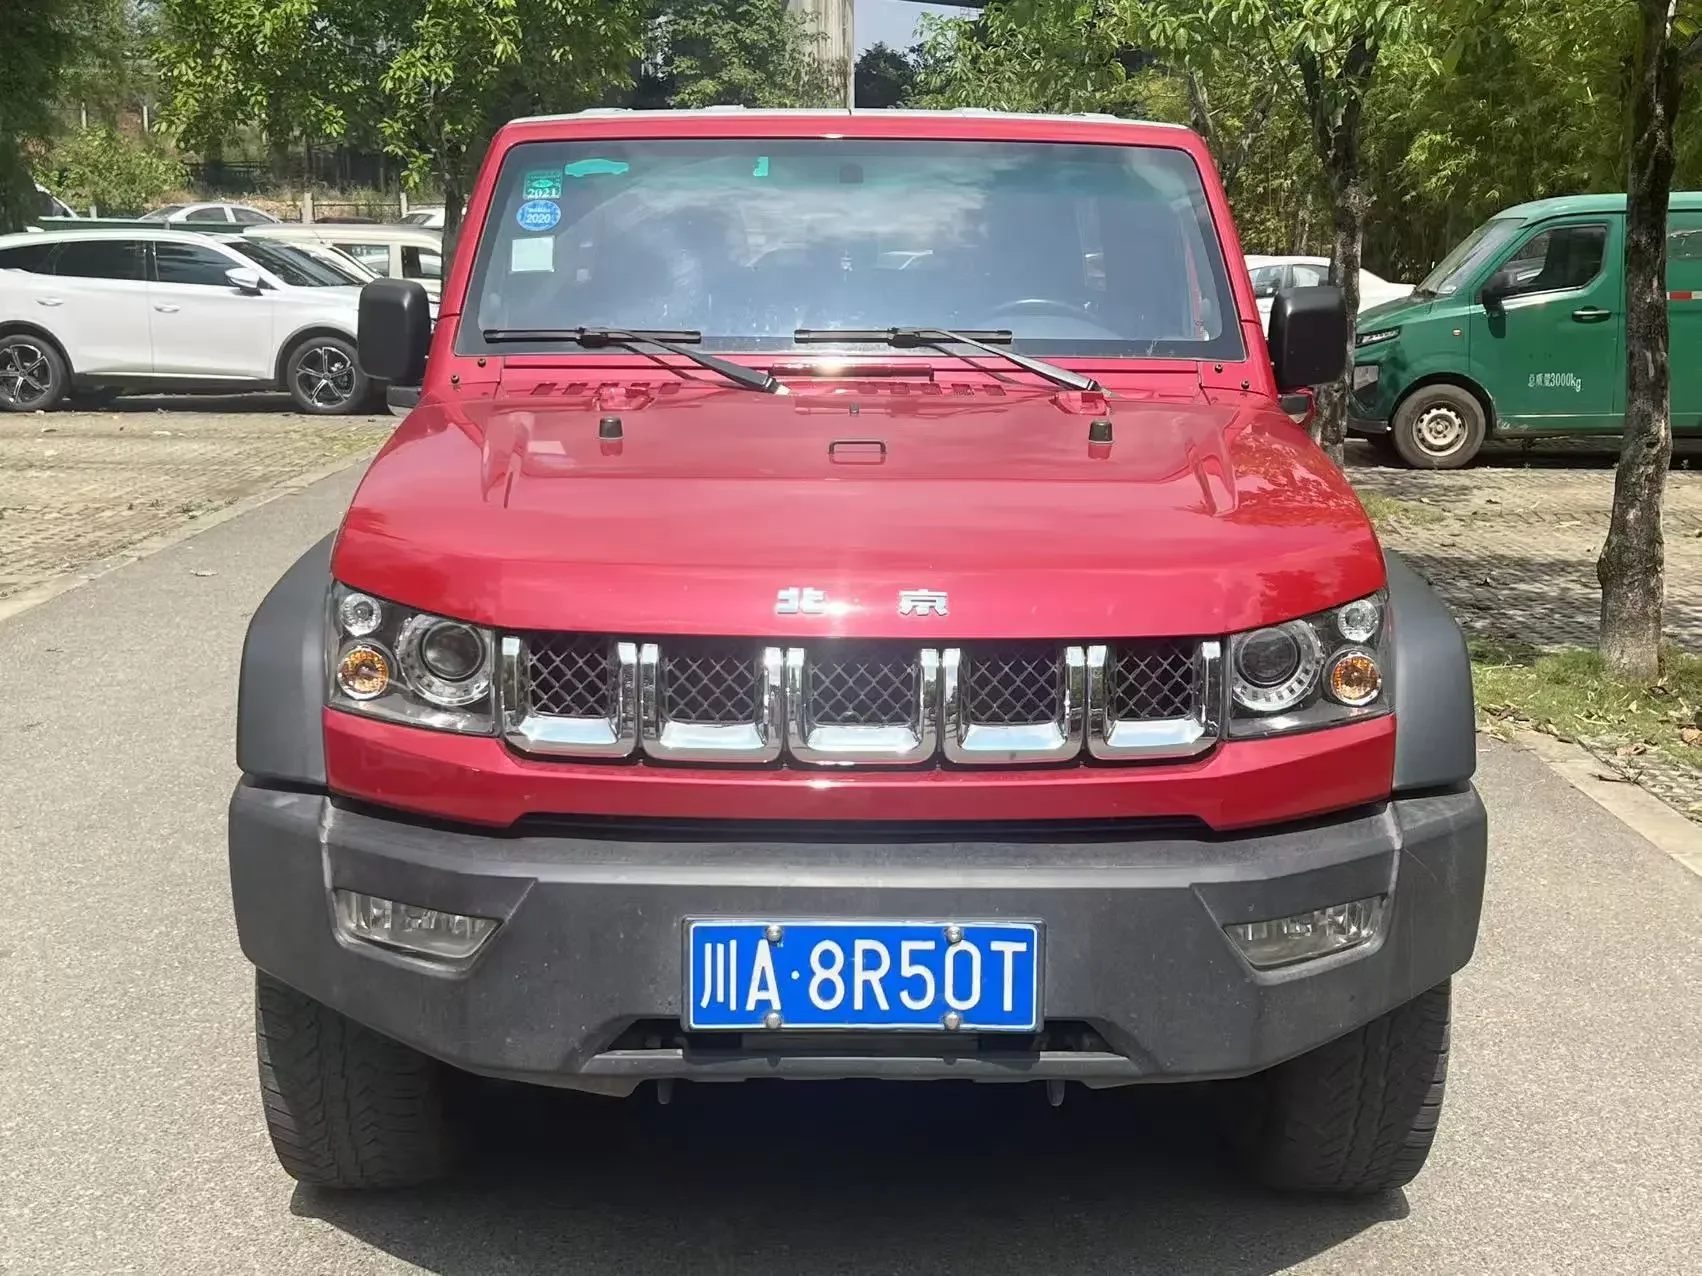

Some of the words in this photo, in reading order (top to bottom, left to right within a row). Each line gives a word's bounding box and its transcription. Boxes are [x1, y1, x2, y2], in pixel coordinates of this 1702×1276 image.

[527, 188, 558, 200] 2021
[526, 213, 551, 224] 2020
[775, 587, 948, 616] 北京
[700, 938, 1027, 1012] 川A·8R50T
